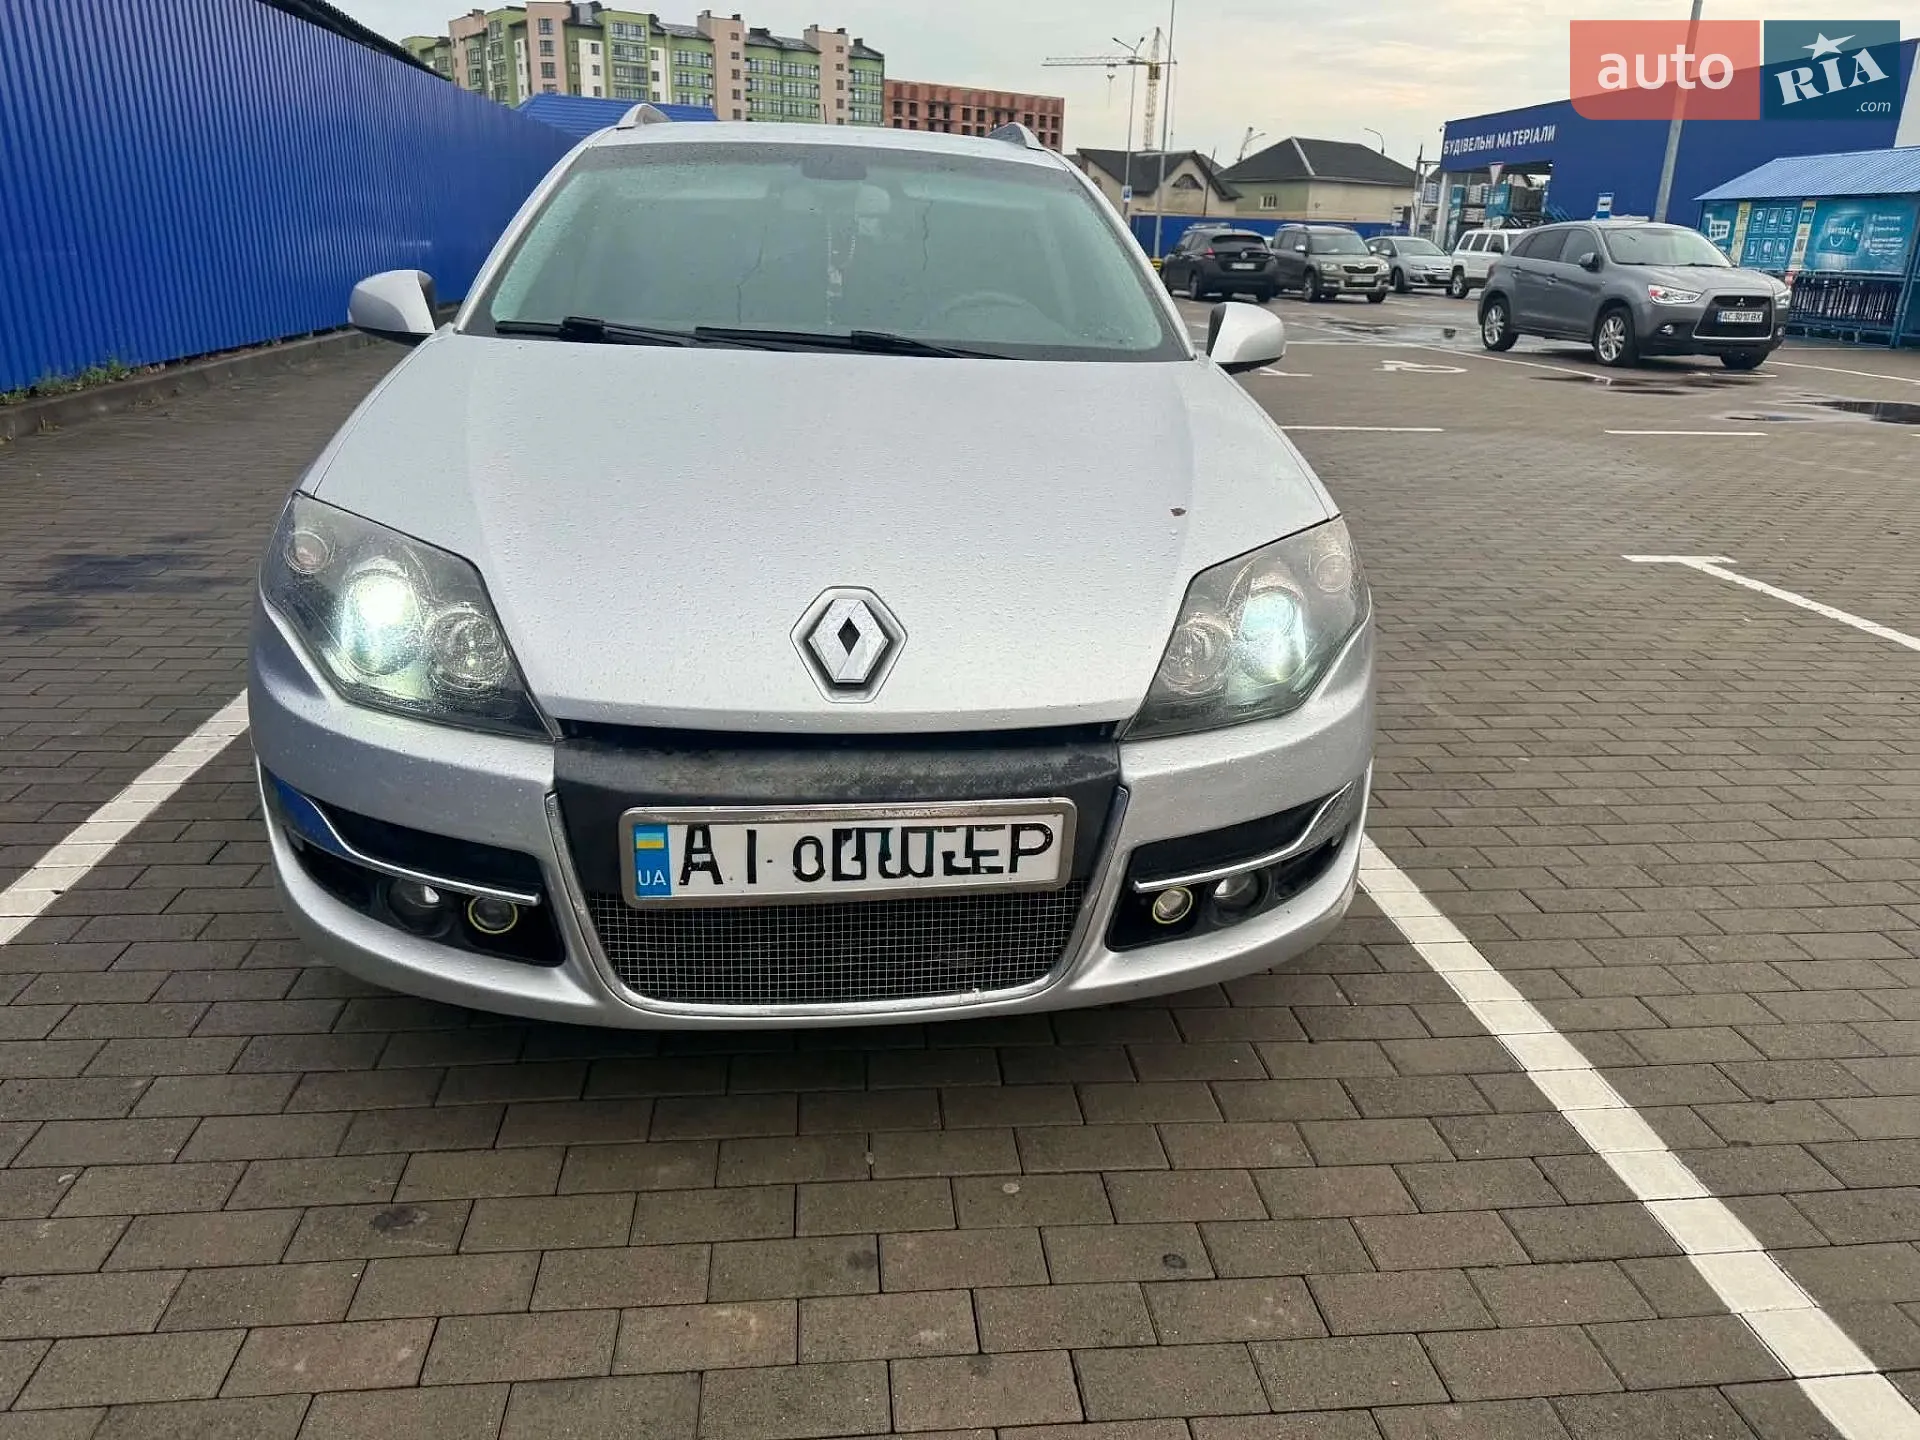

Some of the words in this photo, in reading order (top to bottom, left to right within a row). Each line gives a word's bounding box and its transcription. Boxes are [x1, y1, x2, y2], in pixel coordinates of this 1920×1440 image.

[1443, 134, 1496, 156] БУДІВЕЛЬНІ
[1497, 124, 1556, 149] МАТЕРІАЛИ
[638, 870, 666, 886] UA
